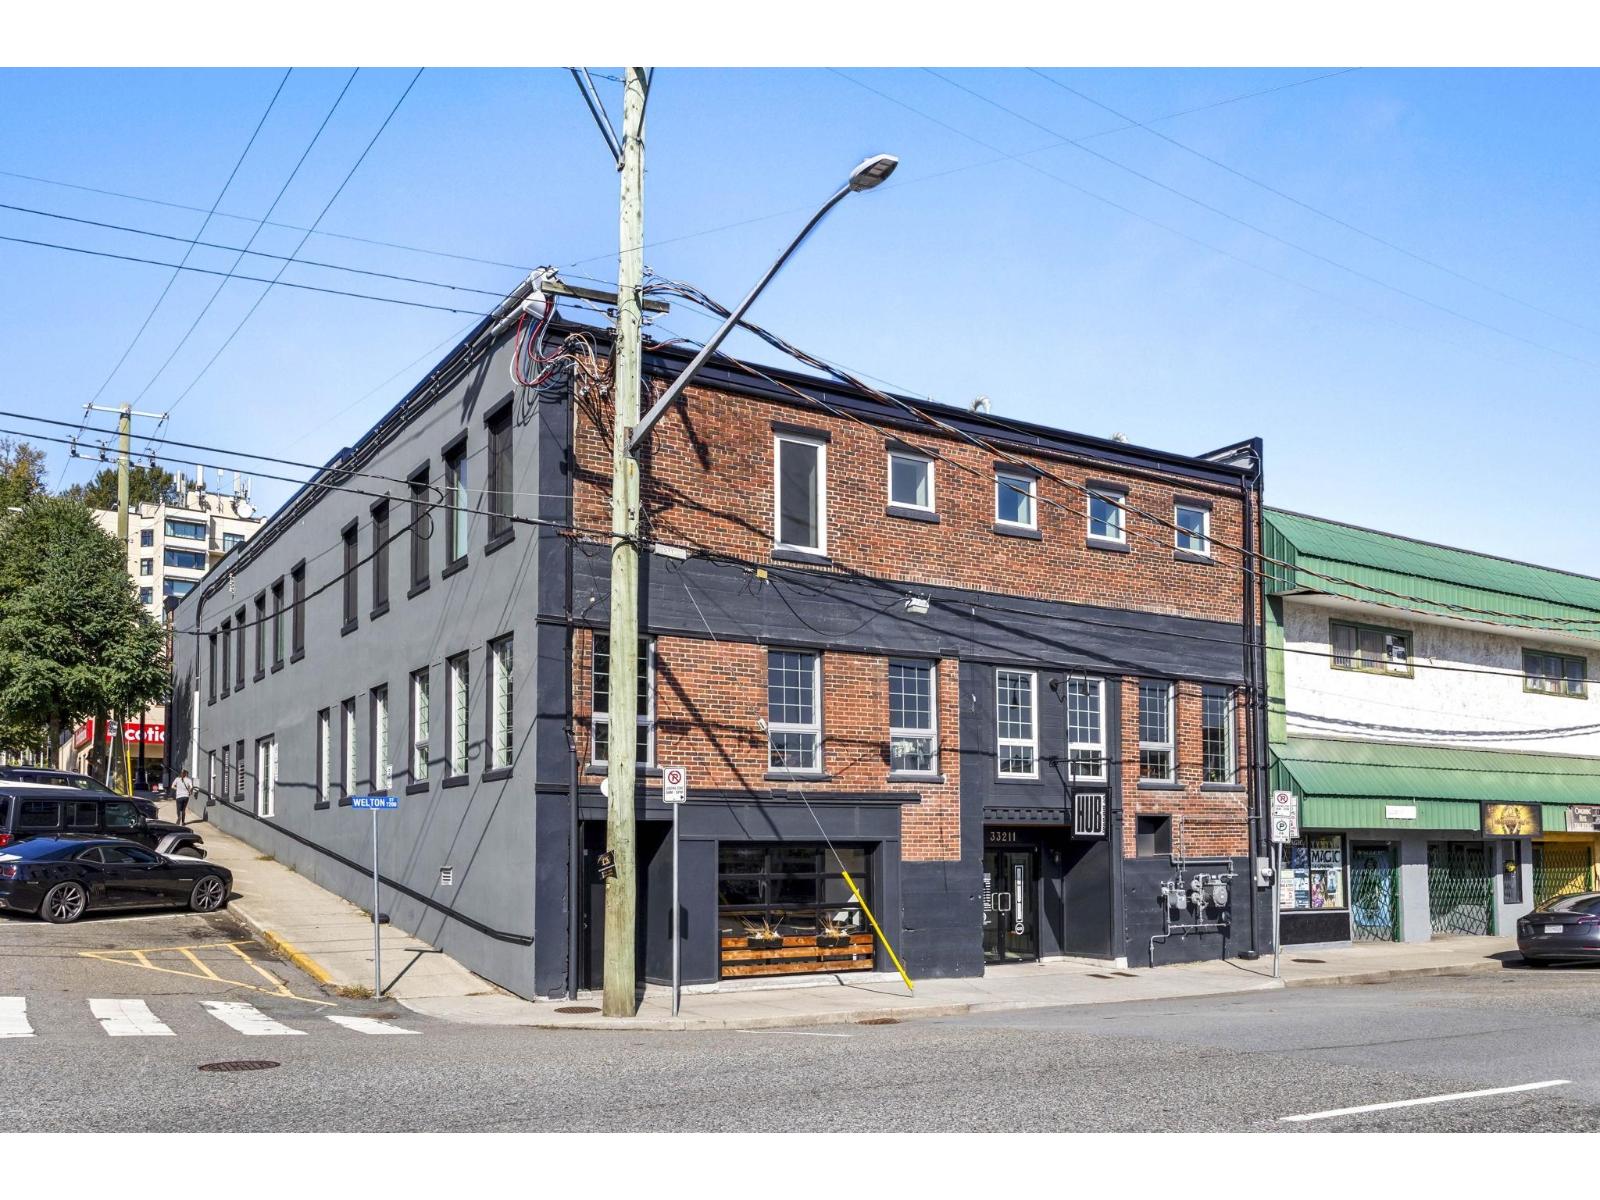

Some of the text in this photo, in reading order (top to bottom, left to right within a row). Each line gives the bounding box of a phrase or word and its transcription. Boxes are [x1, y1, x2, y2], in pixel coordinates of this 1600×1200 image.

[352, 798, 385, 807] WELTON
[1077, 795, 1102, 833] HUB
[990, 831, 1016, 842] 33211
[1311, 850, 1340, 863] MAGIC
